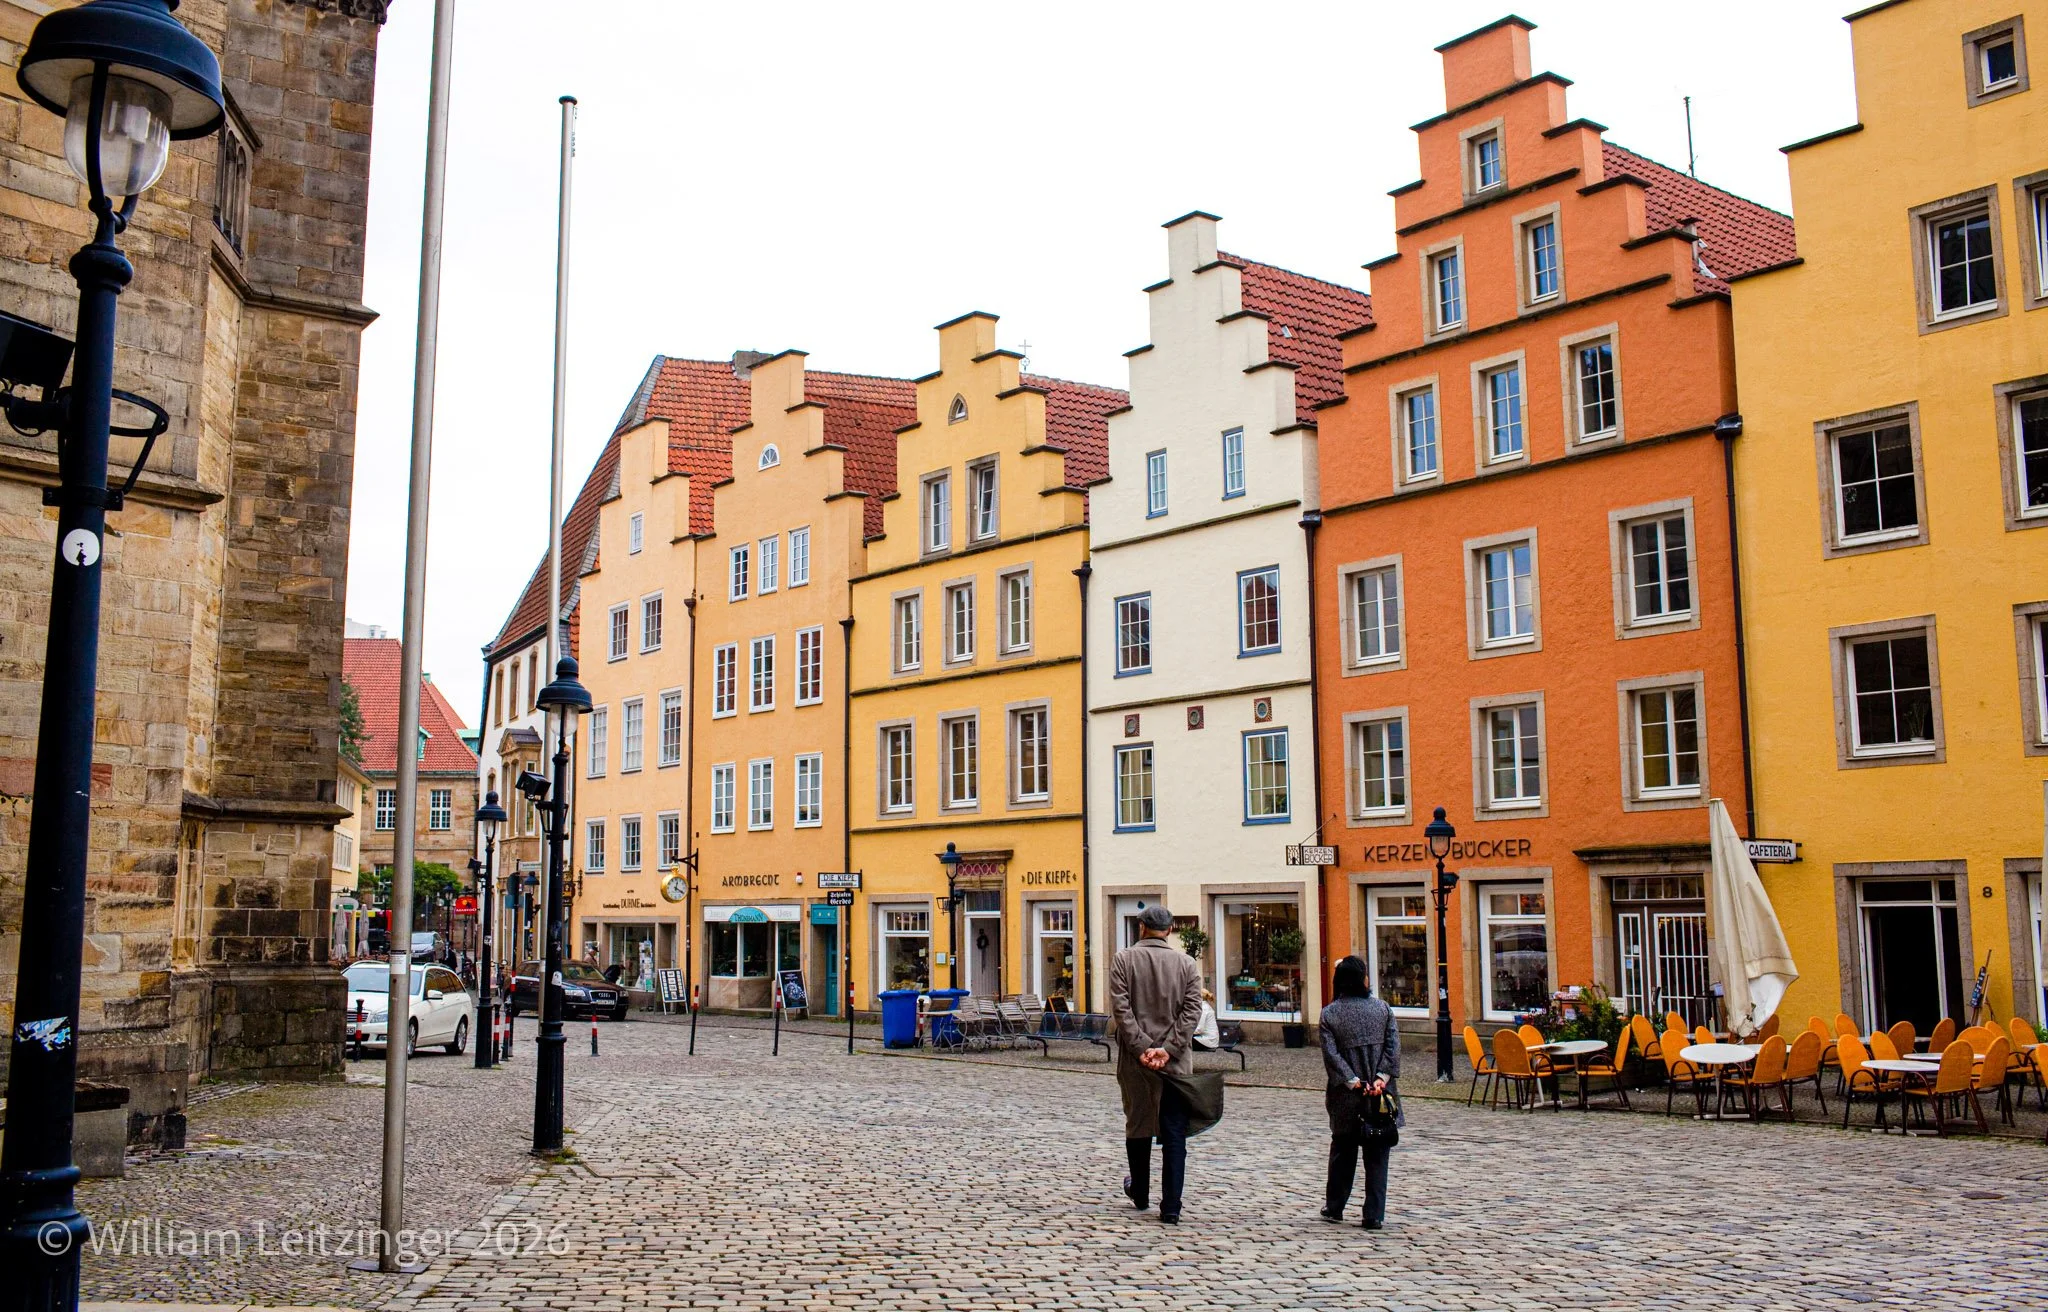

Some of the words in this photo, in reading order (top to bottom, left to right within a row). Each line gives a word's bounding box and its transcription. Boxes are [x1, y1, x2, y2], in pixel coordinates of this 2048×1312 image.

[1451, 838, 1532, 860] BÜCKER
[1748, 844, 1792, 858] CAFETERIA
[823, 874, 835, 882] DIE
[837, 874, 855, 882] KIEPE
[1027, 871, 1042, 885] DIE
[1045, 870, 1071, 884] KIEPE
[1982, 886, 1993, 898] 8
